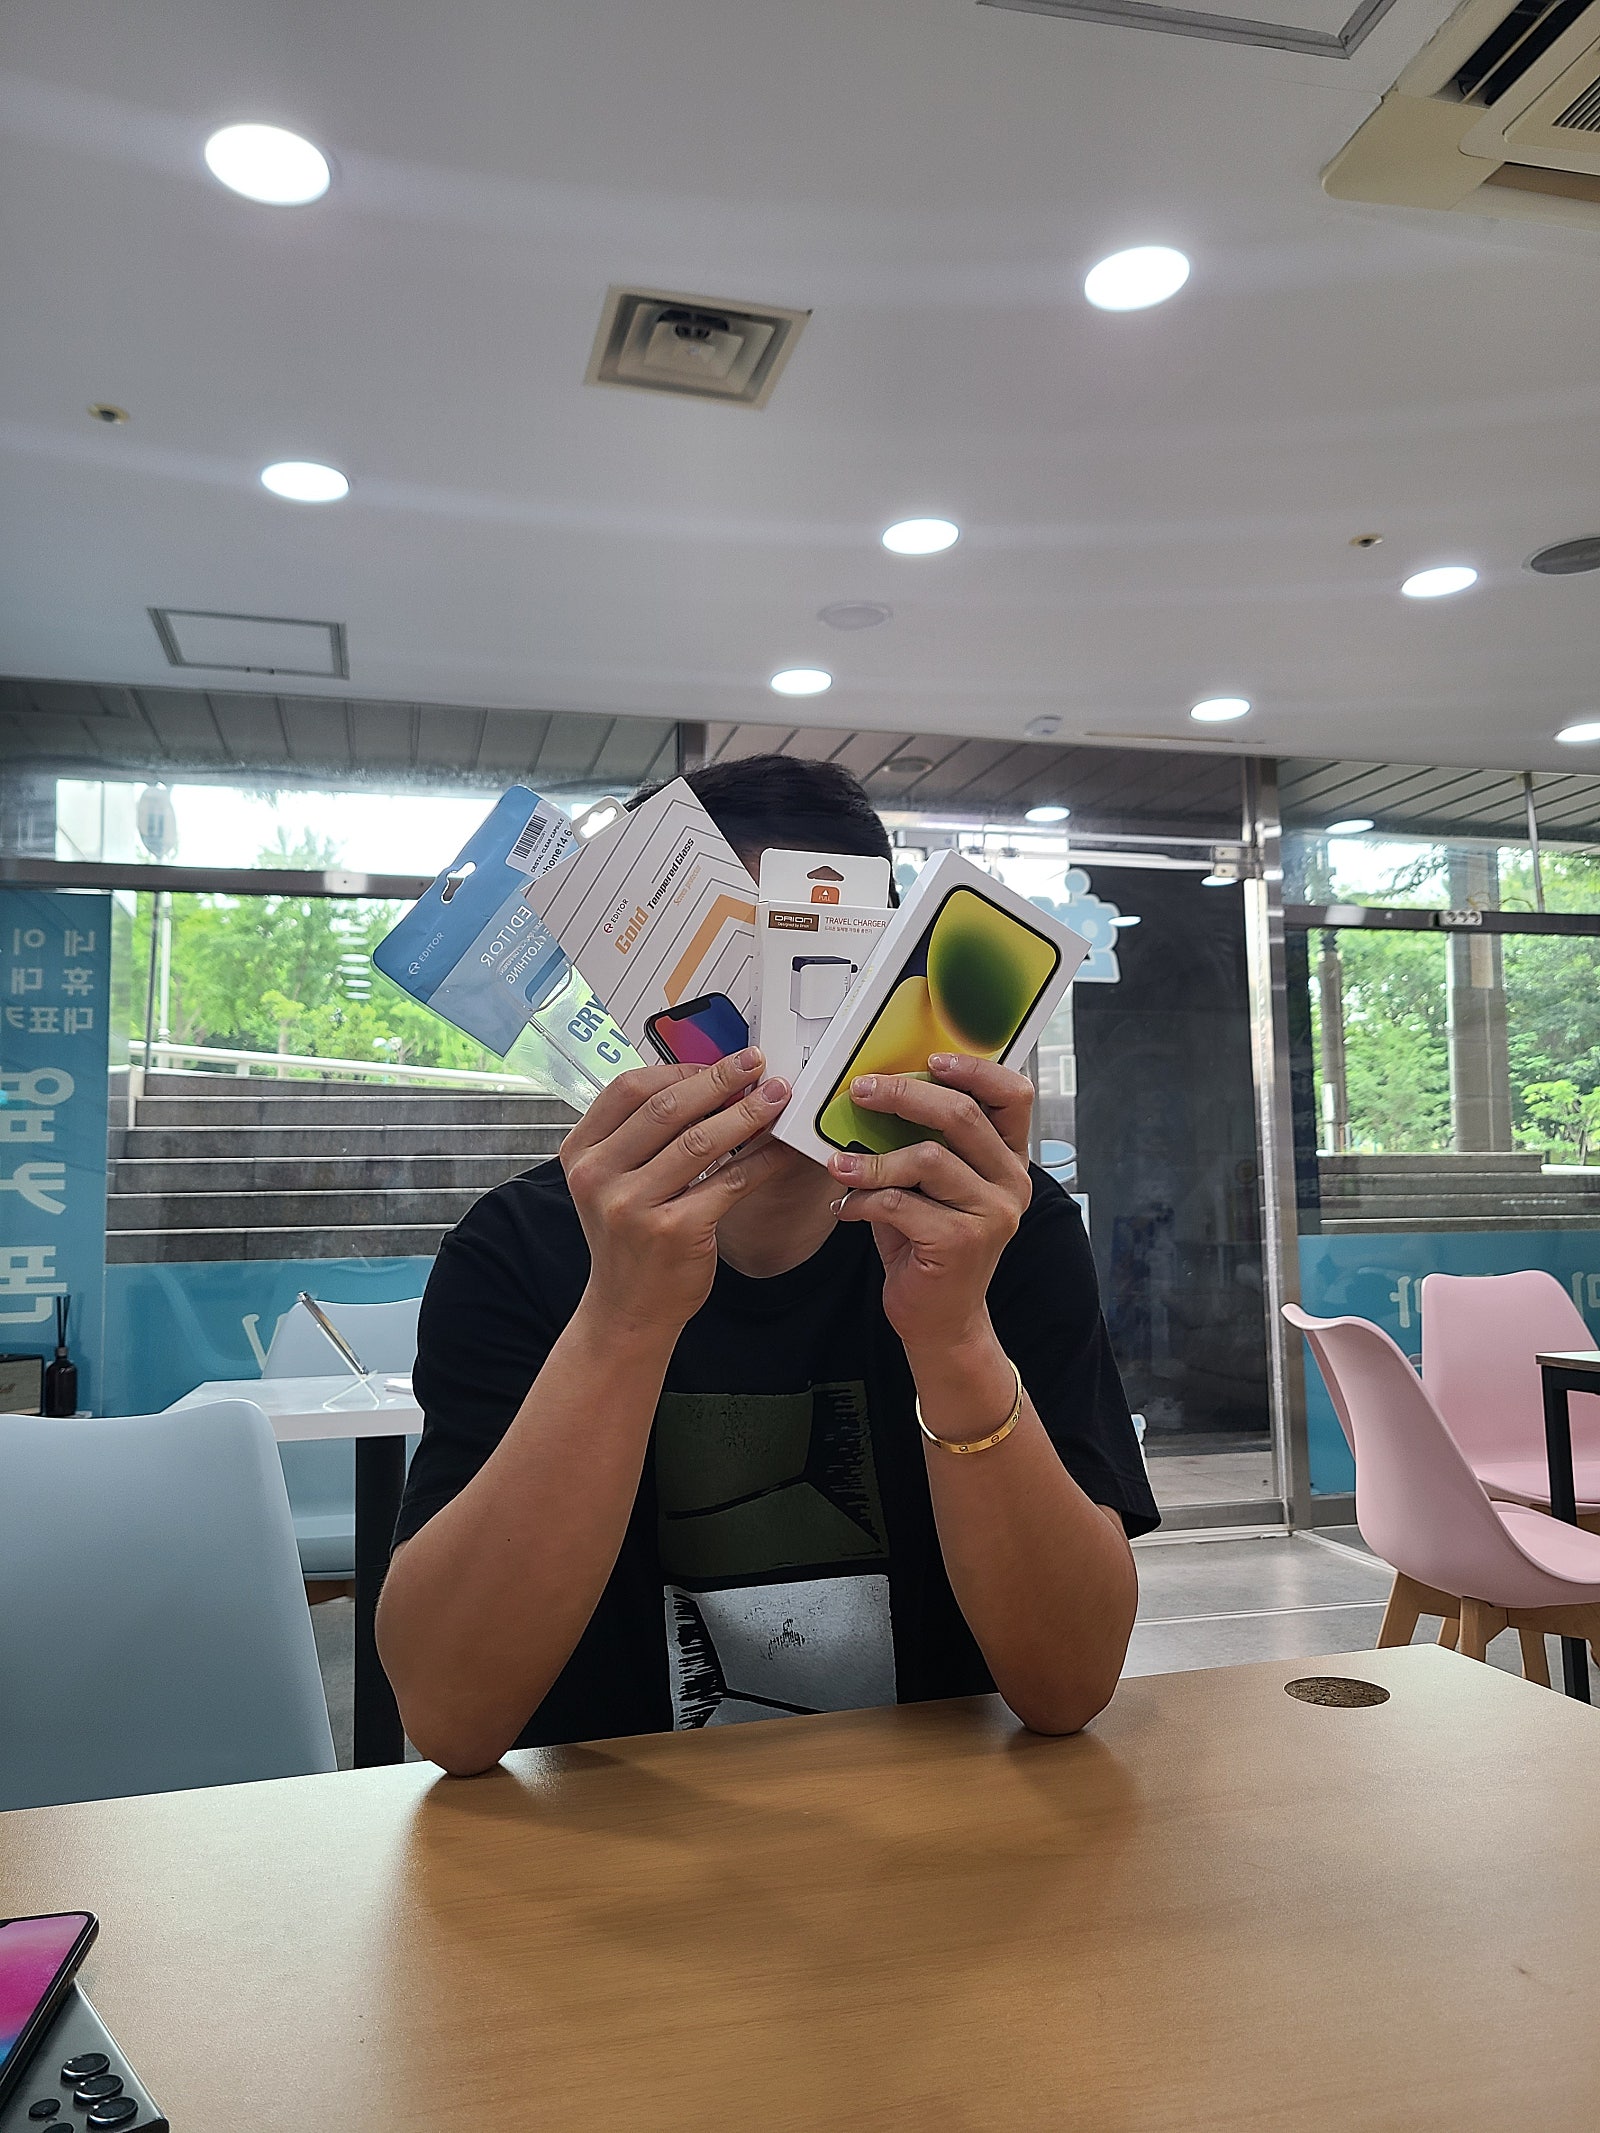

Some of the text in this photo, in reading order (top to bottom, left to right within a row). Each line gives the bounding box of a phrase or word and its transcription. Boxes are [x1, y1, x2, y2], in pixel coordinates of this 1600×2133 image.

[541, 838, 552, 853] CLEAR
[550, 818, 565, 838] CAPSULE
[538, 837, 569, 877] hone14
[611, 898, 629, 923] EDITOR
[614, 838, 695, 954] Gold Tempered Glass
[824, 917, 887, 928] TRAVEL CHARGER
[418, 931, 445, 962] EDITOR
